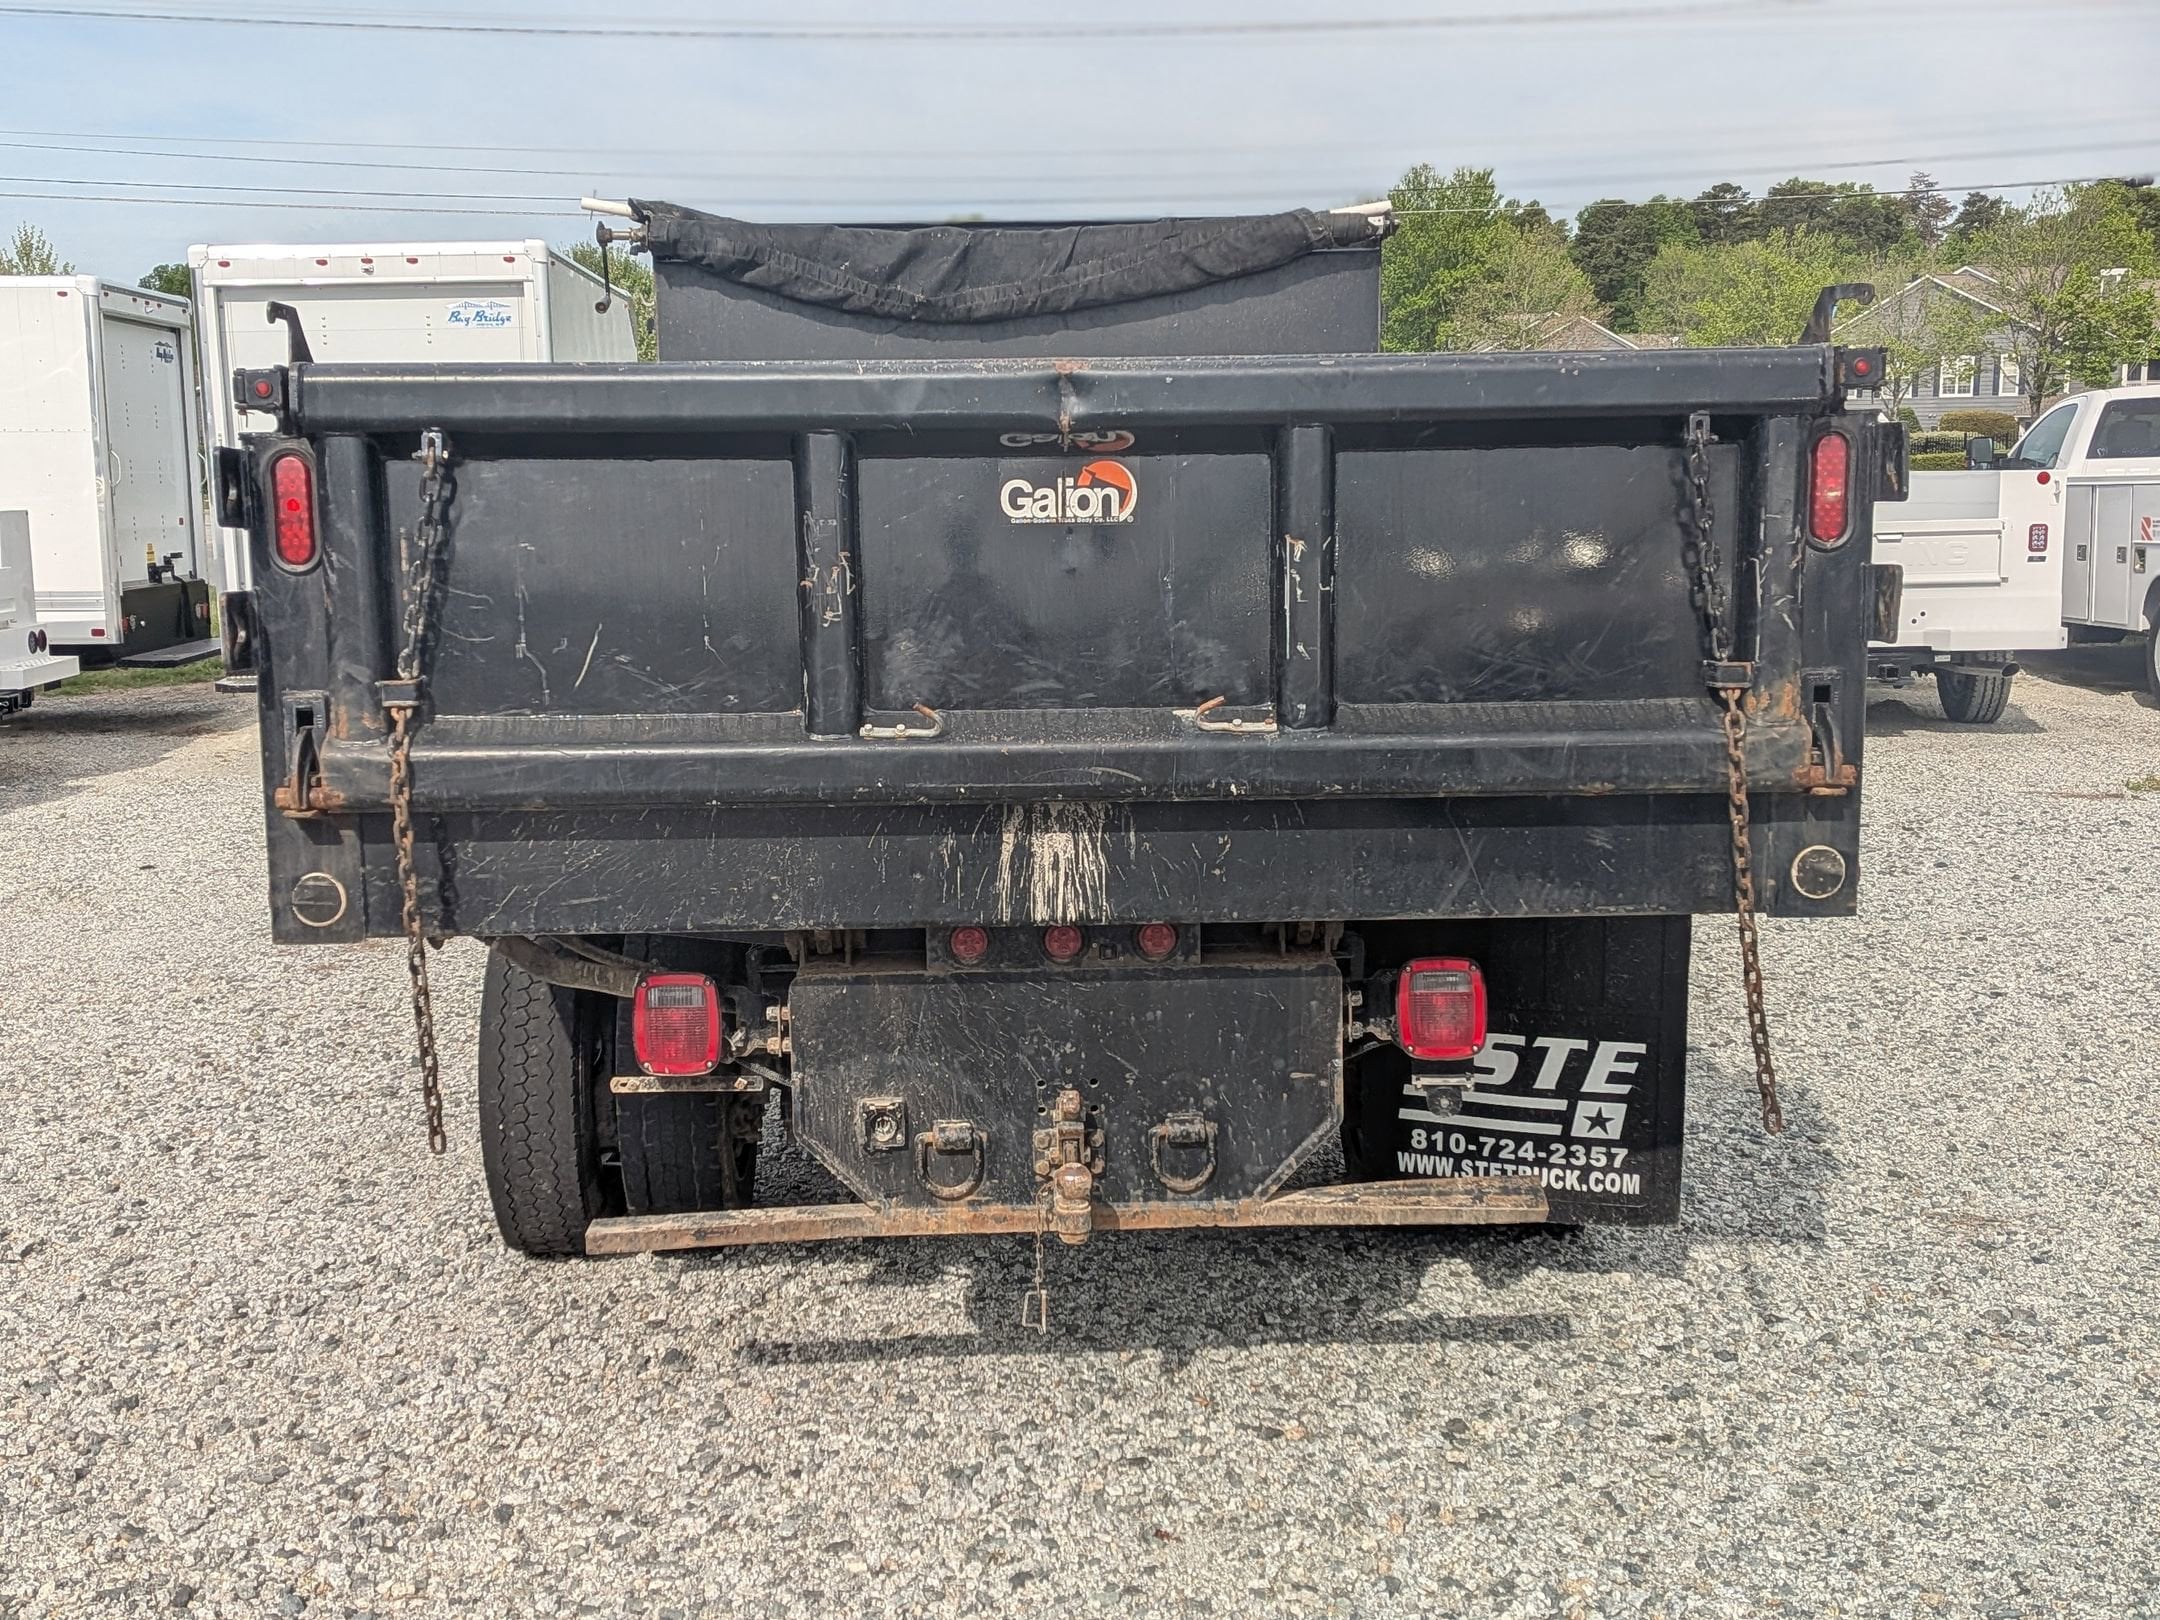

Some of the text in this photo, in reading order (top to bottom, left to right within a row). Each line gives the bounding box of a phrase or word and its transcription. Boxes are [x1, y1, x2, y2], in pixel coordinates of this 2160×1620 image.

[448, 310, 512, 328] Bay Bridge
[1000, 477, 1119, 519] Galion
[1473, 1033, 1647, 1094] STE
[1410, 1128, 1629, 1168] 810-724-2357
